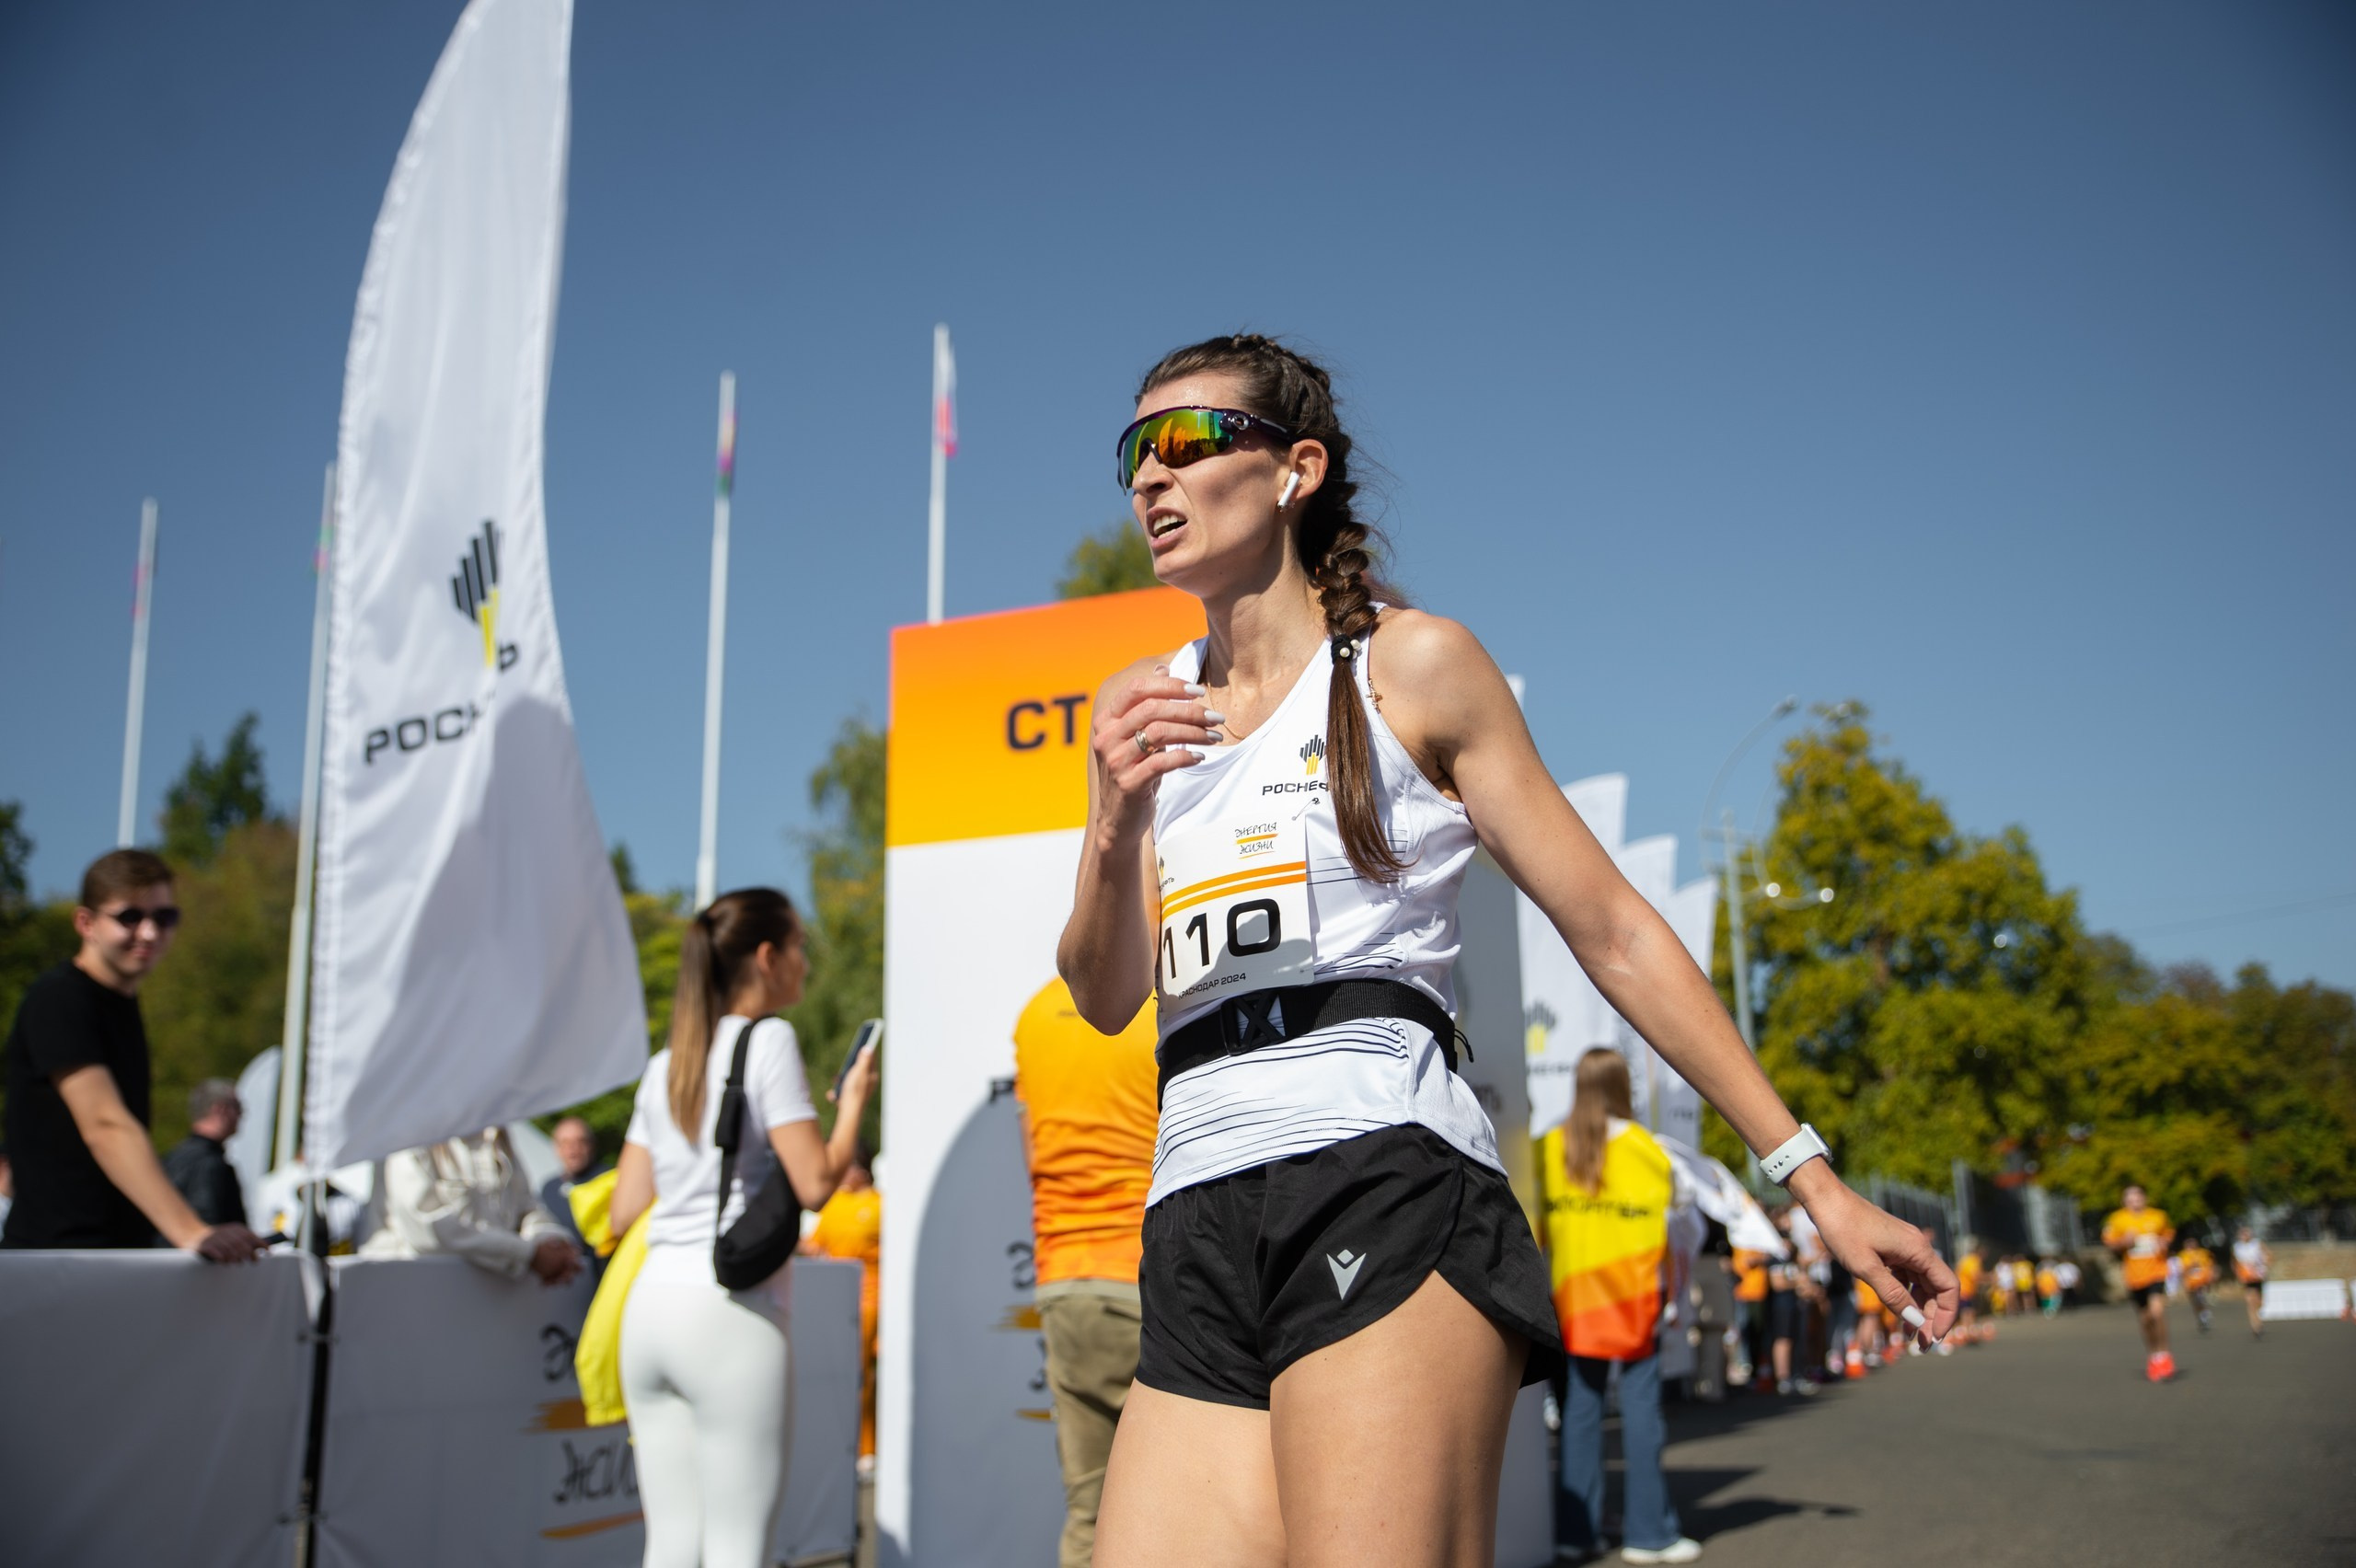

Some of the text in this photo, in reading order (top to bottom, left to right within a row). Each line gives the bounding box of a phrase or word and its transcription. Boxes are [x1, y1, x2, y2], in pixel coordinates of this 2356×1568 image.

[1007, 692, 1088, 751] СТ
[1234, 822, 1277, 838] ЭНЕРГИЯ
[1239, 840, 1274, 855] ЖИЗНИ
[1162, 898, 1281, 979] 110
[1178, 973, 1247, 1000] КРАСНОДАР 2024
